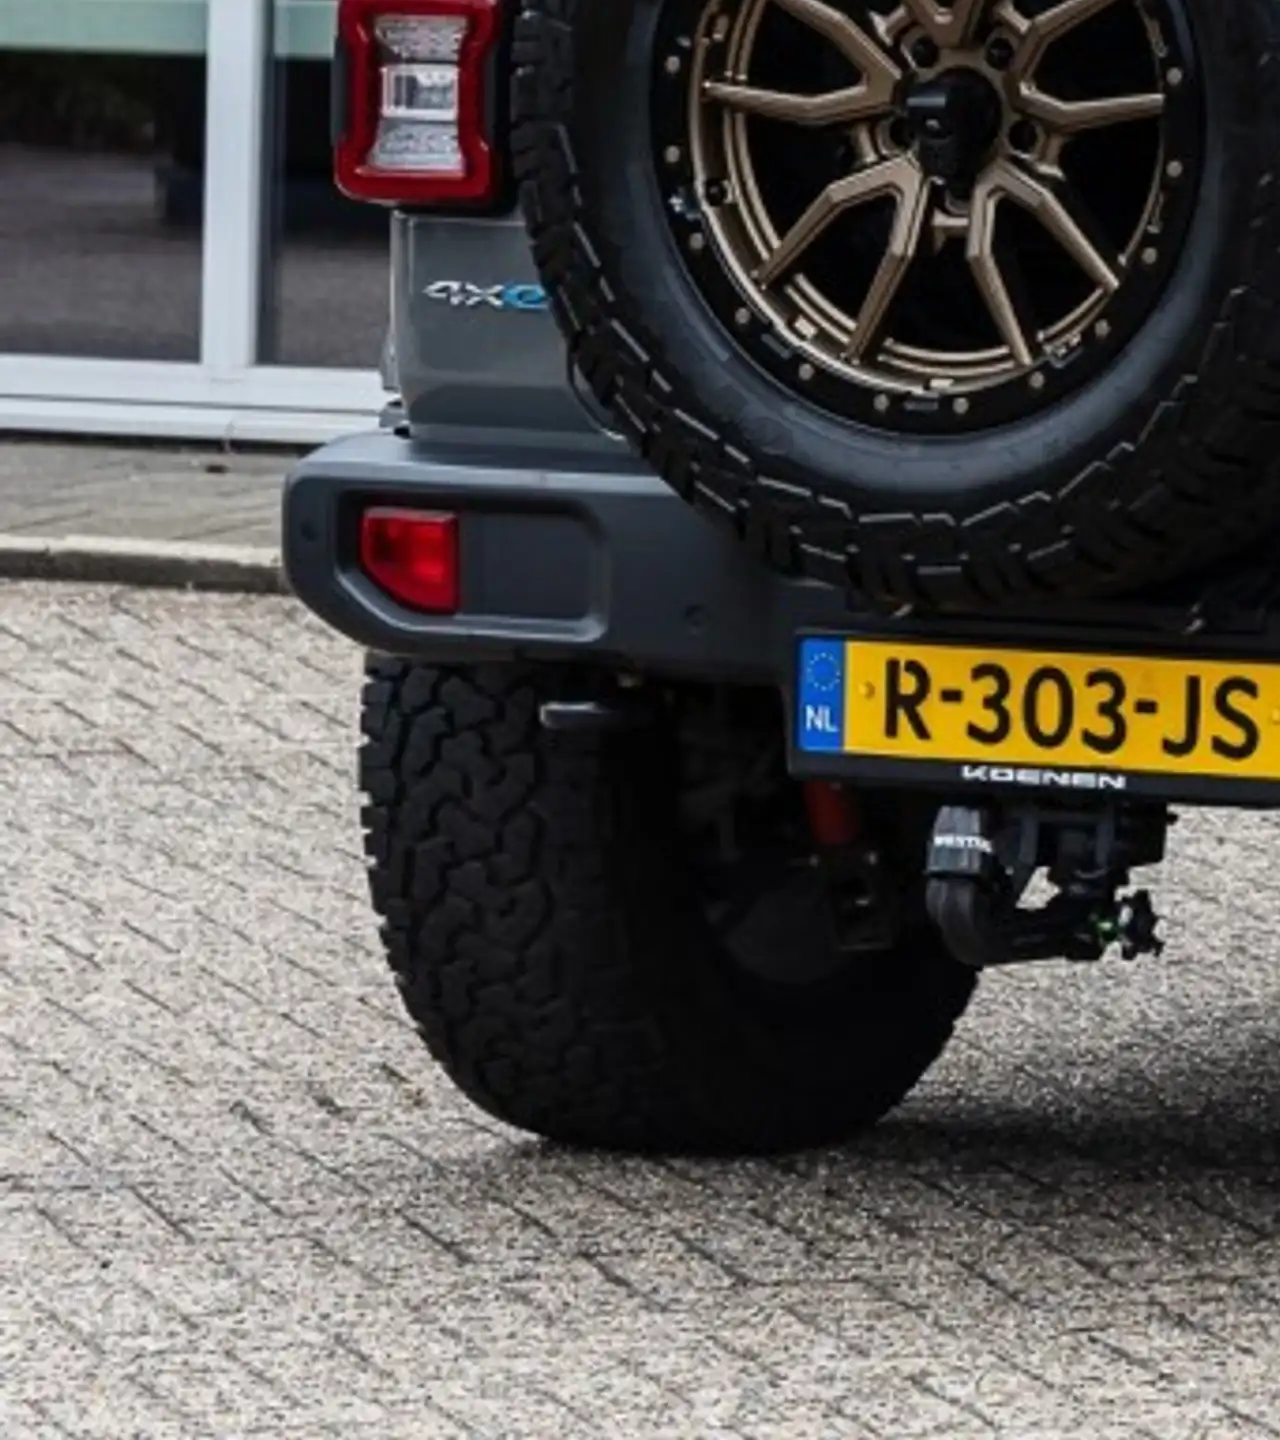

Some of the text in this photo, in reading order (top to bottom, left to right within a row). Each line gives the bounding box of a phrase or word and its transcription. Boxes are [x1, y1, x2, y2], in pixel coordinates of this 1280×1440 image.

[805, 705, 838, 734] NL
[882, 657, 1260, 762] R-303-JS
[961, 764, 1127, 790] KOENEN
